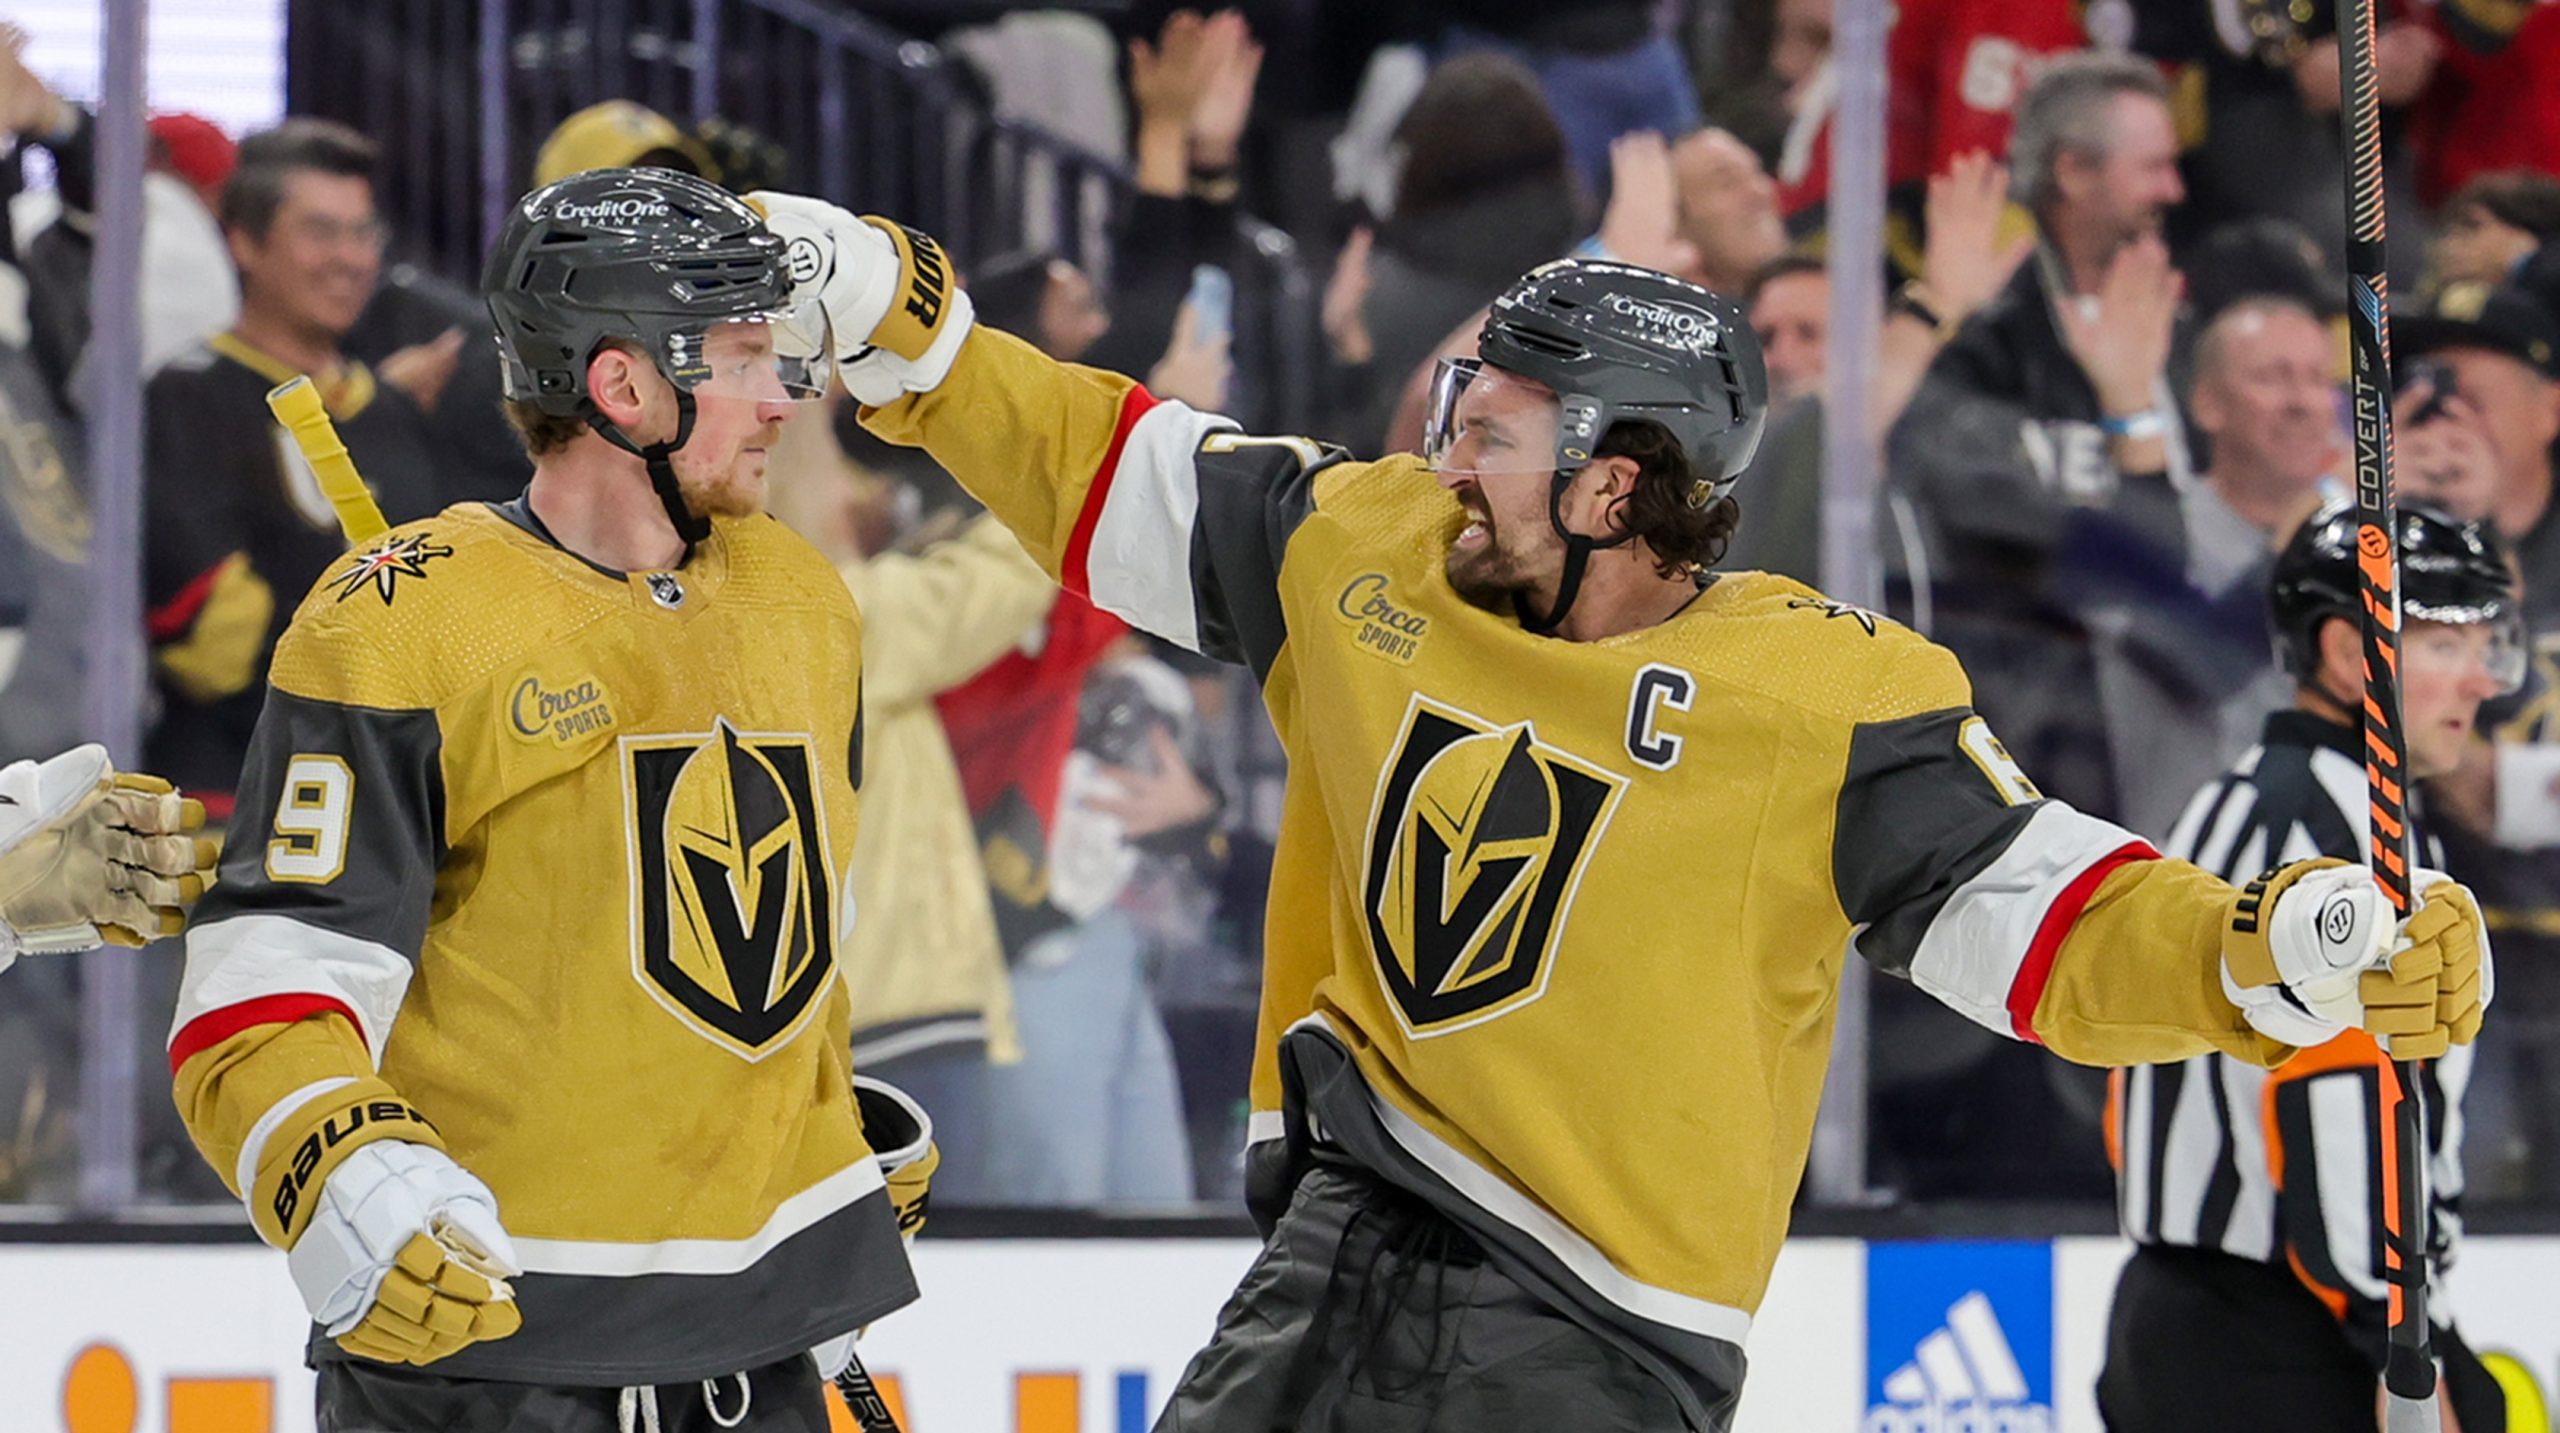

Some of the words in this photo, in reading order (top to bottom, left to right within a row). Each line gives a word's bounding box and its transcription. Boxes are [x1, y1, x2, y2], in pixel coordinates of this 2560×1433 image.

[2355, 374, 2381, 511] COVERT
[1338, 573, 1428, 637] Circa
[1357, 622, 1418, 660] SPORTS
[511, 677, 602, 736] Circa
[553, 703, 613, 742] SPORTS
[1624, 661, 1697, 772] C
[264, 752, 357, 885] 9
